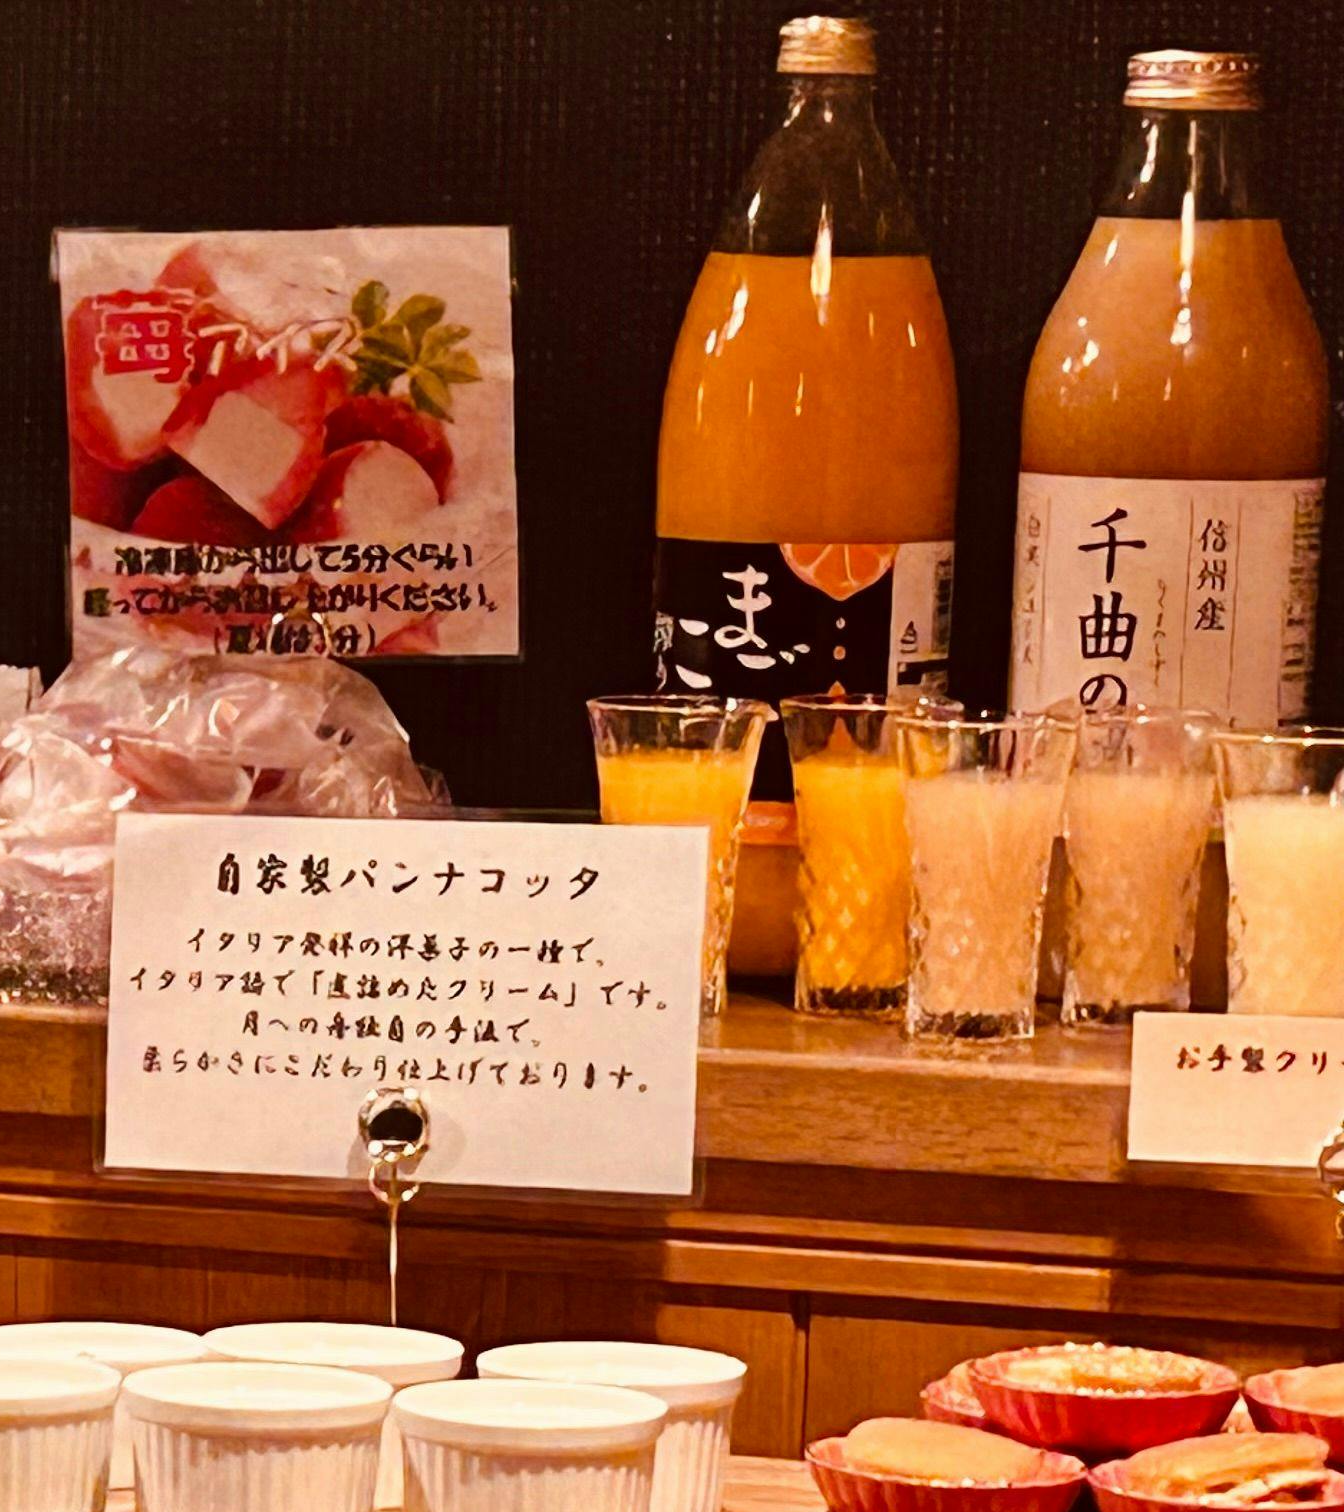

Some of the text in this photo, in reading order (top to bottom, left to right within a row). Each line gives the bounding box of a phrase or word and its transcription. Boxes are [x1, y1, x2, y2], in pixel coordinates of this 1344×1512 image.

[216, 851, 600, 899] 自家製パンナコッタ
